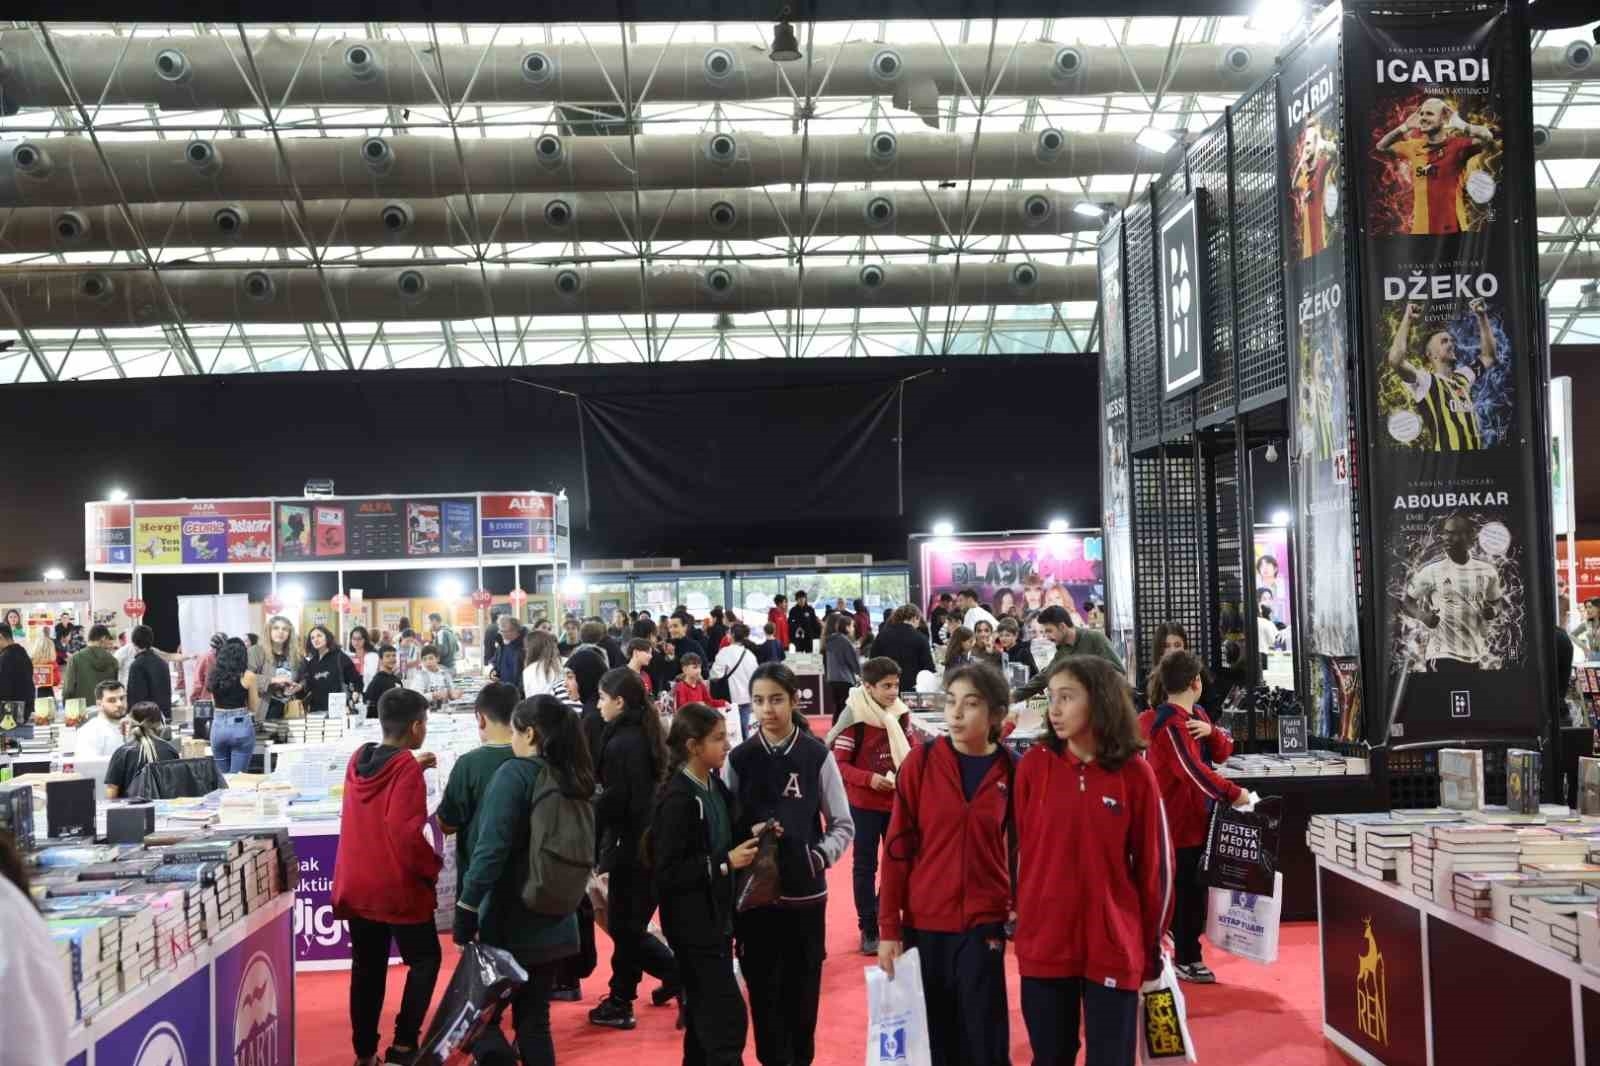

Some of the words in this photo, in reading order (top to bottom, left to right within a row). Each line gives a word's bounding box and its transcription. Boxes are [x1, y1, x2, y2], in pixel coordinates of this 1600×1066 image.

[1376, 58, 1490, 83] ICARDI
[1288, 71, 1333, 128] ICARDI
[1383, 270, 1499, 301] DŽEKO
[360, 501, 393, 513] ALFA
[509, 498, 545, 510] ALFA
[1393, 491, 1509, 509] ABOUBAKAR
[1284, 737, 1298, 748] 50
[782, 772, 803, 798] A
[1221, 823, 1258, 837] DESTEK
[1221, 834, 1257, 849] MEDYA
[1219, 844, 1257, 860] GRUBU
[1357, 988, 1389, 1046] REN
